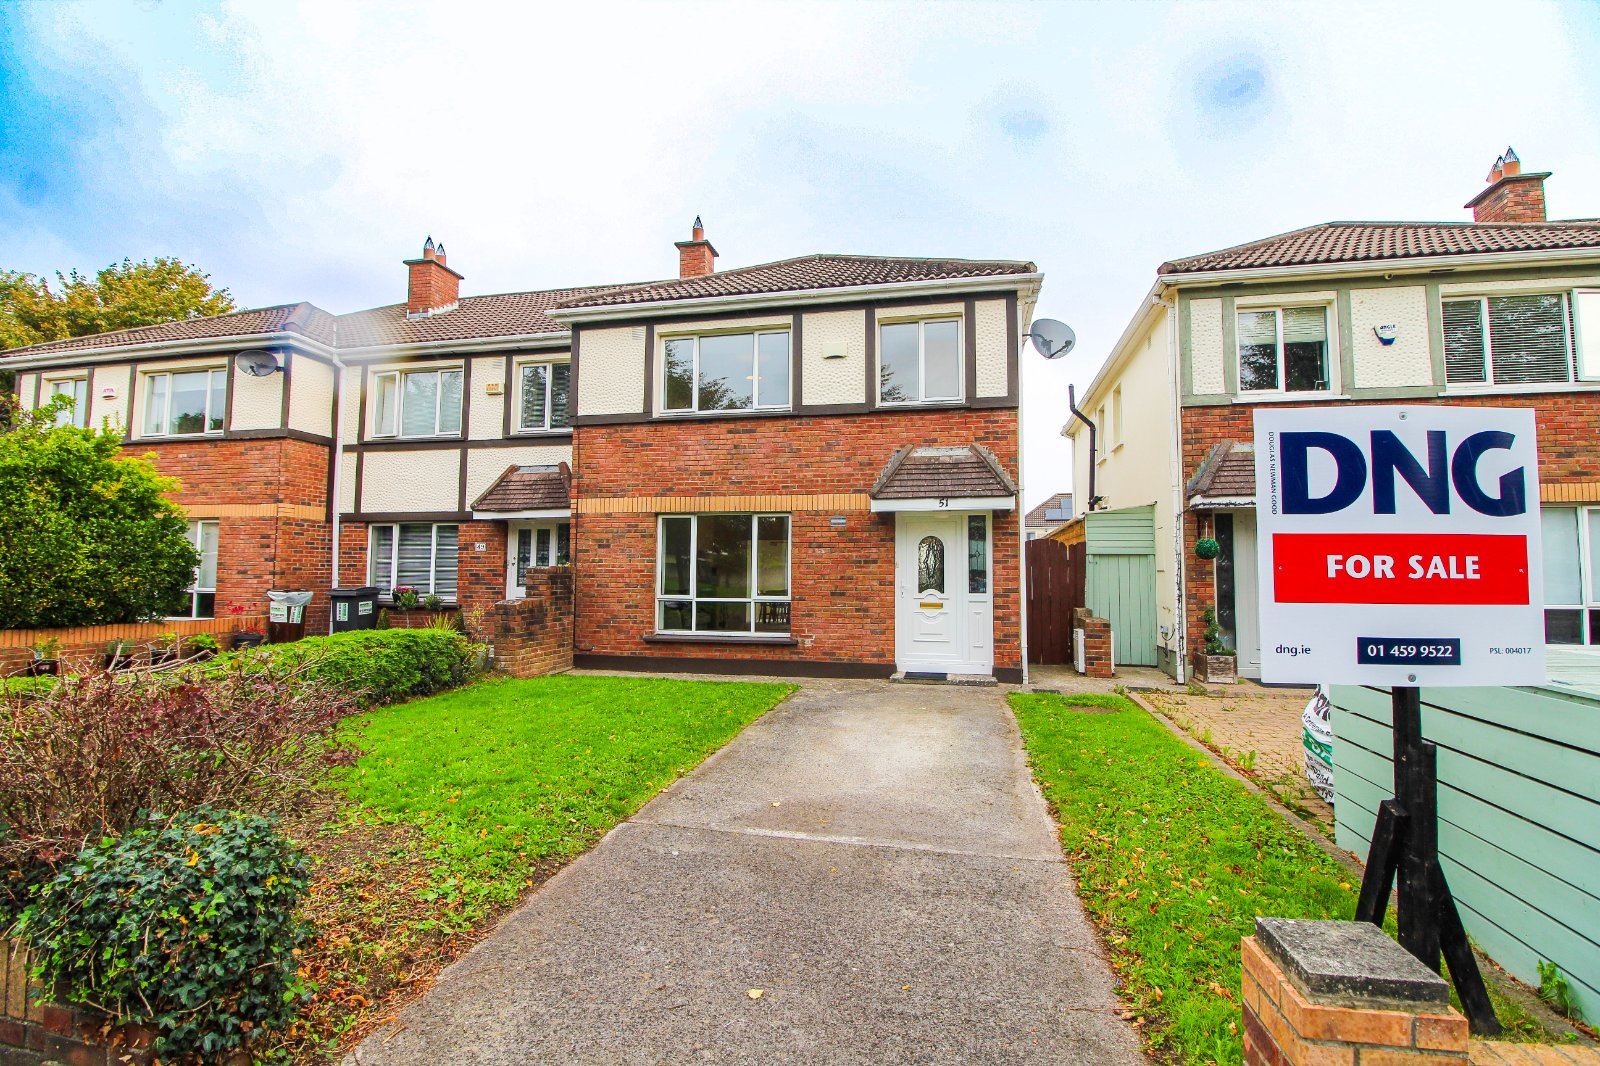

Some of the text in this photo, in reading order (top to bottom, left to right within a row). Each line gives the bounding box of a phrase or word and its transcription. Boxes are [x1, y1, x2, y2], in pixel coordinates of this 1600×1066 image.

[1268, 431, 1276, 462] DOUGLAS
[1269, 463, 1277, 494] NEWMAN
[1279, 429, 1526, 517] DNG
[938, 497, 948, 508] 51
[1327, 554, 1481, 580] FOR SALE
[1275, 644, 1311, 656] dng.ie
[1367, 644, 1453, 657] 01 459 9522
[1489, 647, 1532, 655] PSL: 004017
